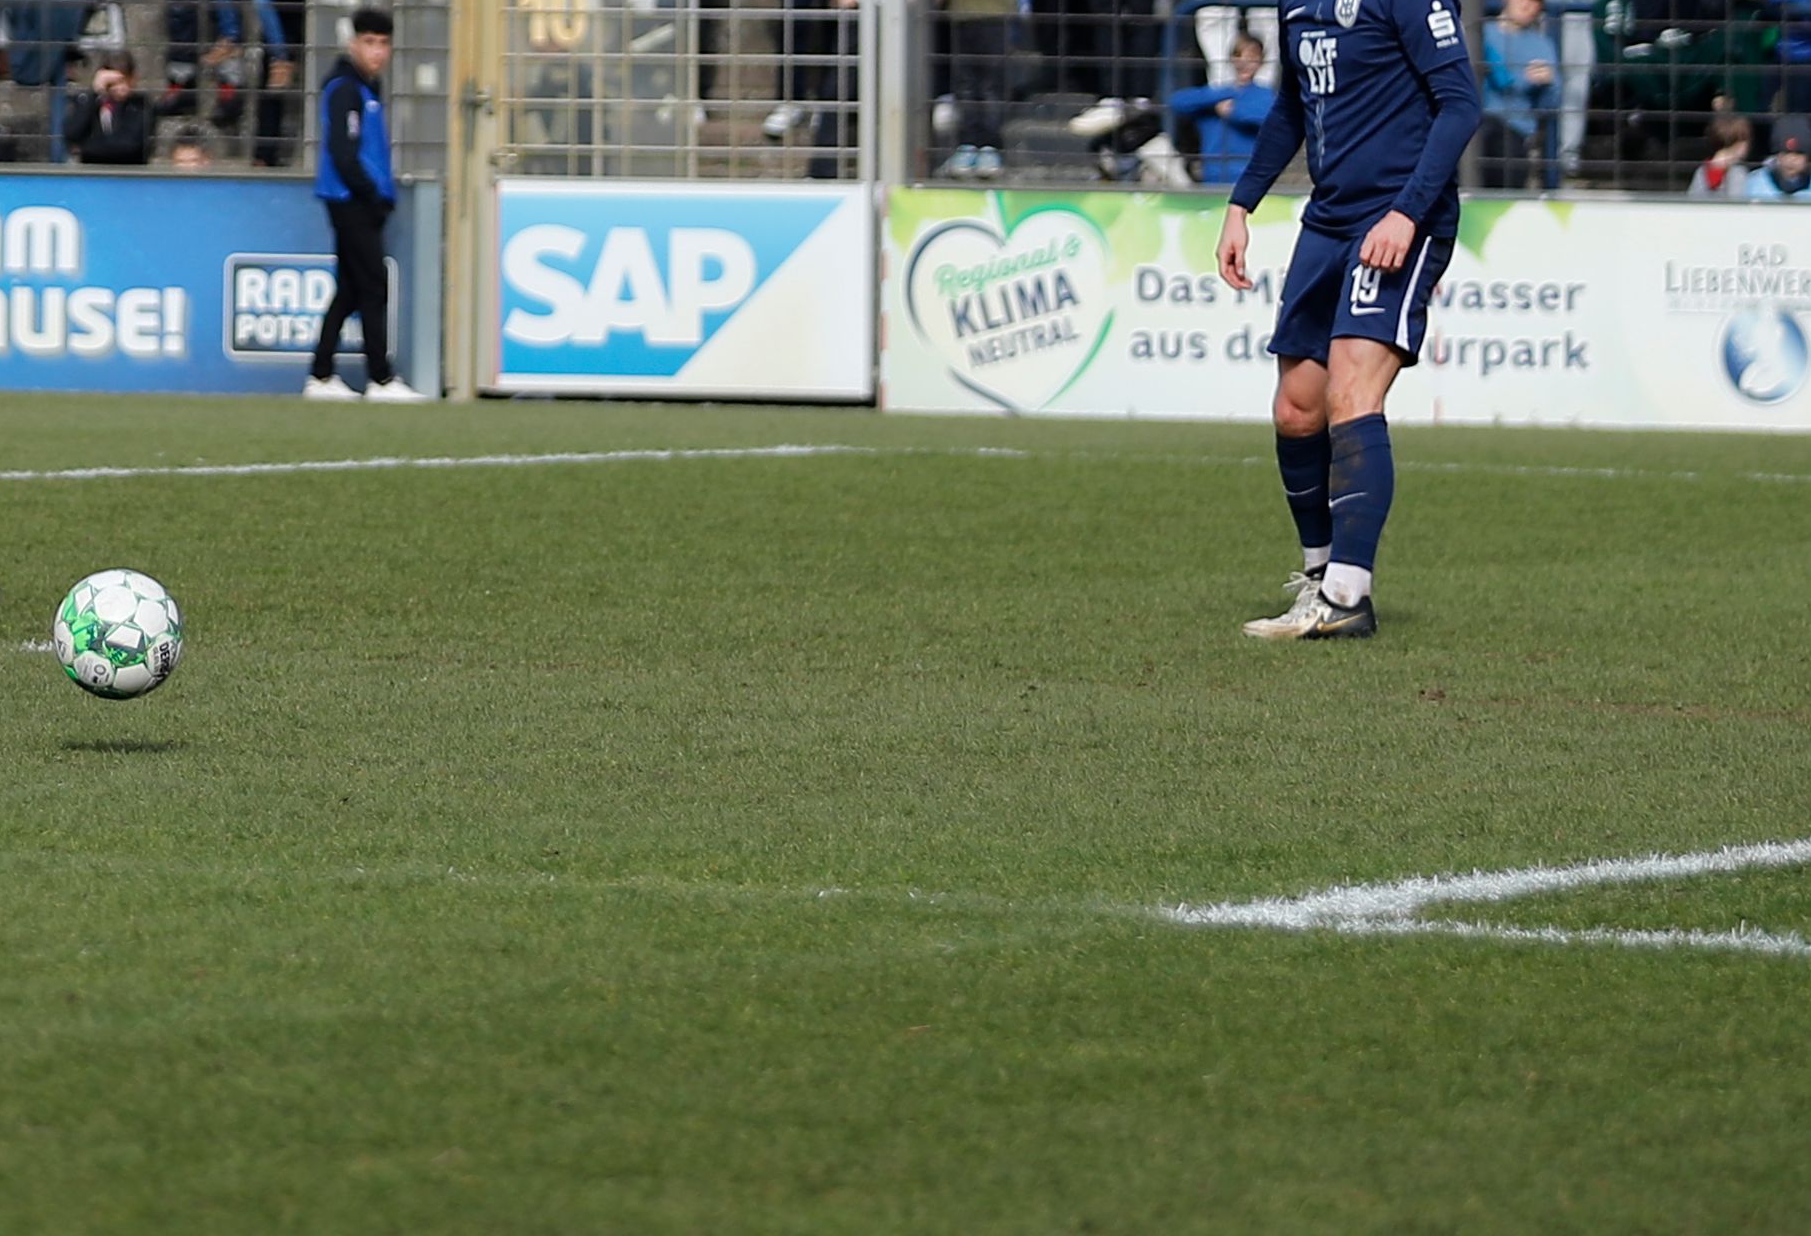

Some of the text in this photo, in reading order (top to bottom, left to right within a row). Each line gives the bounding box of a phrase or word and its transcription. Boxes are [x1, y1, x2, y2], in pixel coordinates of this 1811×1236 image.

[935, 237, 1059, 296] Regional
[1665, 260, 1811, 294] LIEBENWER
[1737, 243, 1788, 266] BAD
[236, 268, 338, 313] RAD
[503, 224, 758, 346] SAP
[949, 268, 1081, 338] KLIMA
[1138, 267, 1218, 304] Das
[1350, 265, 1381, 303] 19
[967, 315, 1081, 367] NEUTRAL
[1130, 323, 1588, 376] aus de urpark
